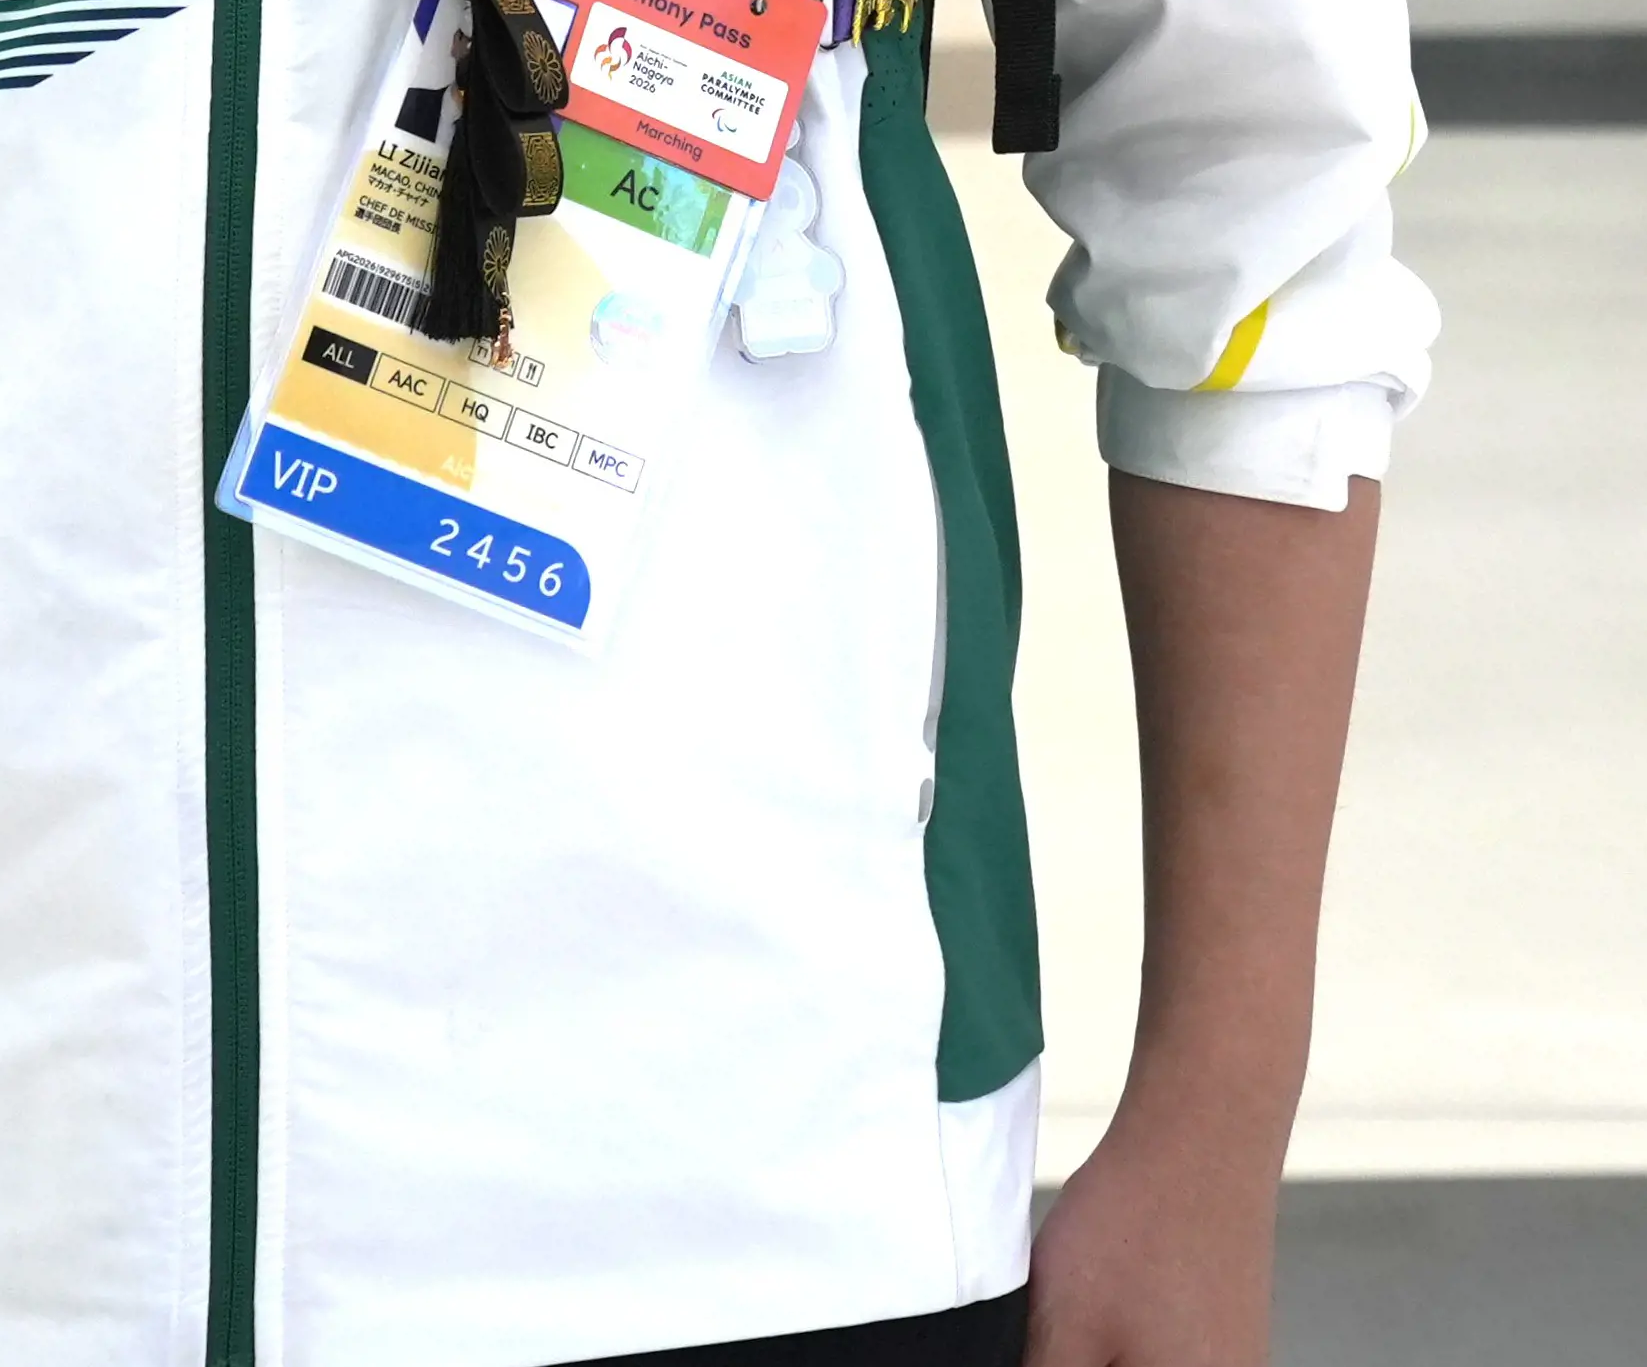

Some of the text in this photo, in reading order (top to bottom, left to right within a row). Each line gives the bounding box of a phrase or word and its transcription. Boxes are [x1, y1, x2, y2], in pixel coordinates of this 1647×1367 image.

[699, 12, 753, 49] Pass
[632, 61, 674, 86] Nagoya
[636, 51, 669, 70] Aichi-
[628, 74, 656, 94] 2026
[702, 73, 766, 107] PARALYMPIC
[720, 71, 753, 90] ASIAN
[700, 83, 761, 115] COMMITTEE
[377, 139, 398, 161] LI
[636, 119, 703, 161] Marching
[370, 163, 412, 188] MACAO,
[359, 195, 387, 215] CHEF
[389, 206, 405, 222] DE
[322, 342, 630, 478] ALL AAC HQ IBC MPC
[272, 450, 338, 503] VIP
